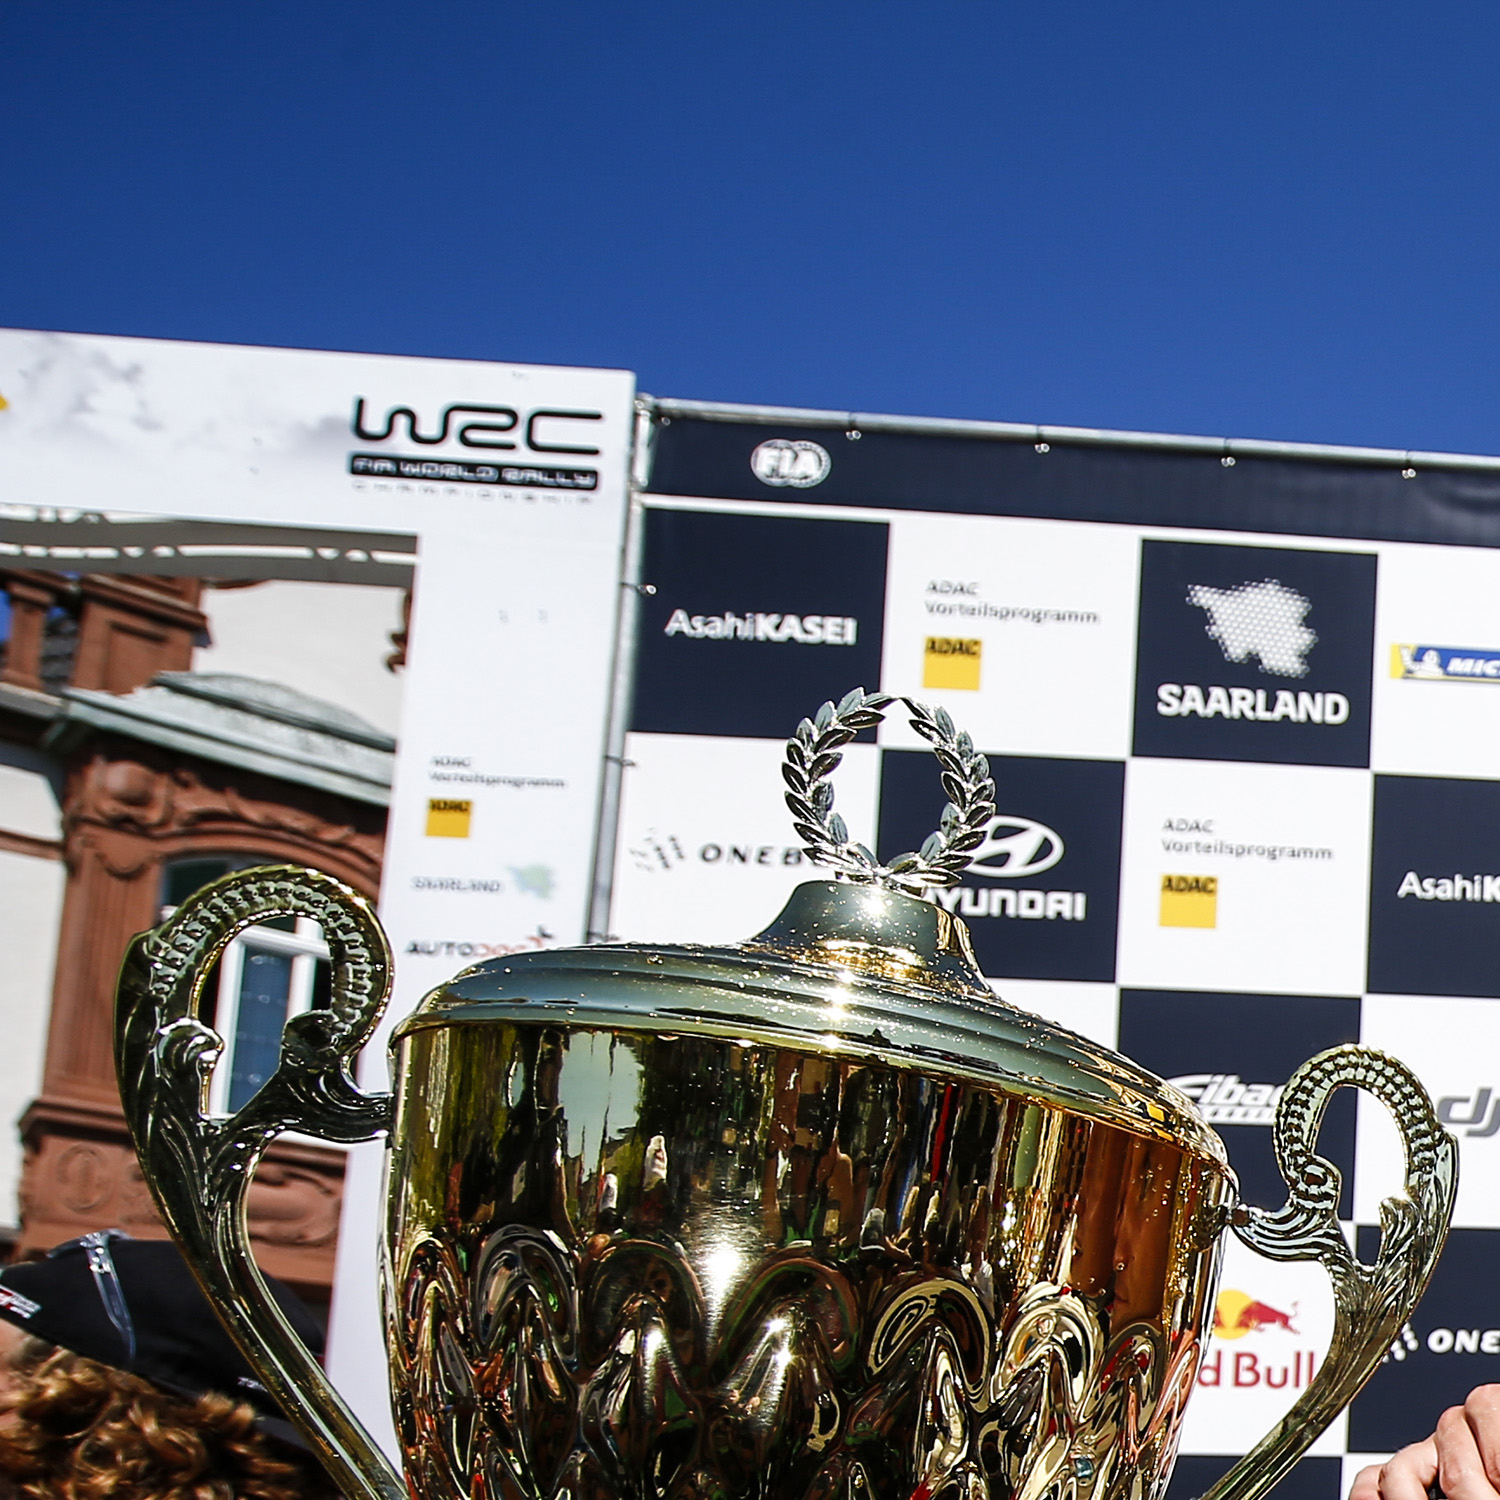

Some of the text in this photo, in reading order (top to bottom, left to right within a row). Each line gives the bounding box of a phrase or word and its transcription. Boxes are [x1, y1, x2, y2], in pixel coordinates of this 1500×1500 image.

[354, 397, 602, 455] WRC
[757, 449, 820, 478] FIA
[926, 580, 979, 596] ADAC
[664, 608, 858, 648] AsahiKASEI
[926, 637, 980, 658] ADAC
[1157, 683, 1350, 725] SAARLAND
[1162, 819, 1214, 834] ADAC
[1161, 838, 1333, 862] Vorteilsprogramm
[1162, 876, 1217, 896] ADAC
[1232, 1351, 1315, 1390] Bull
